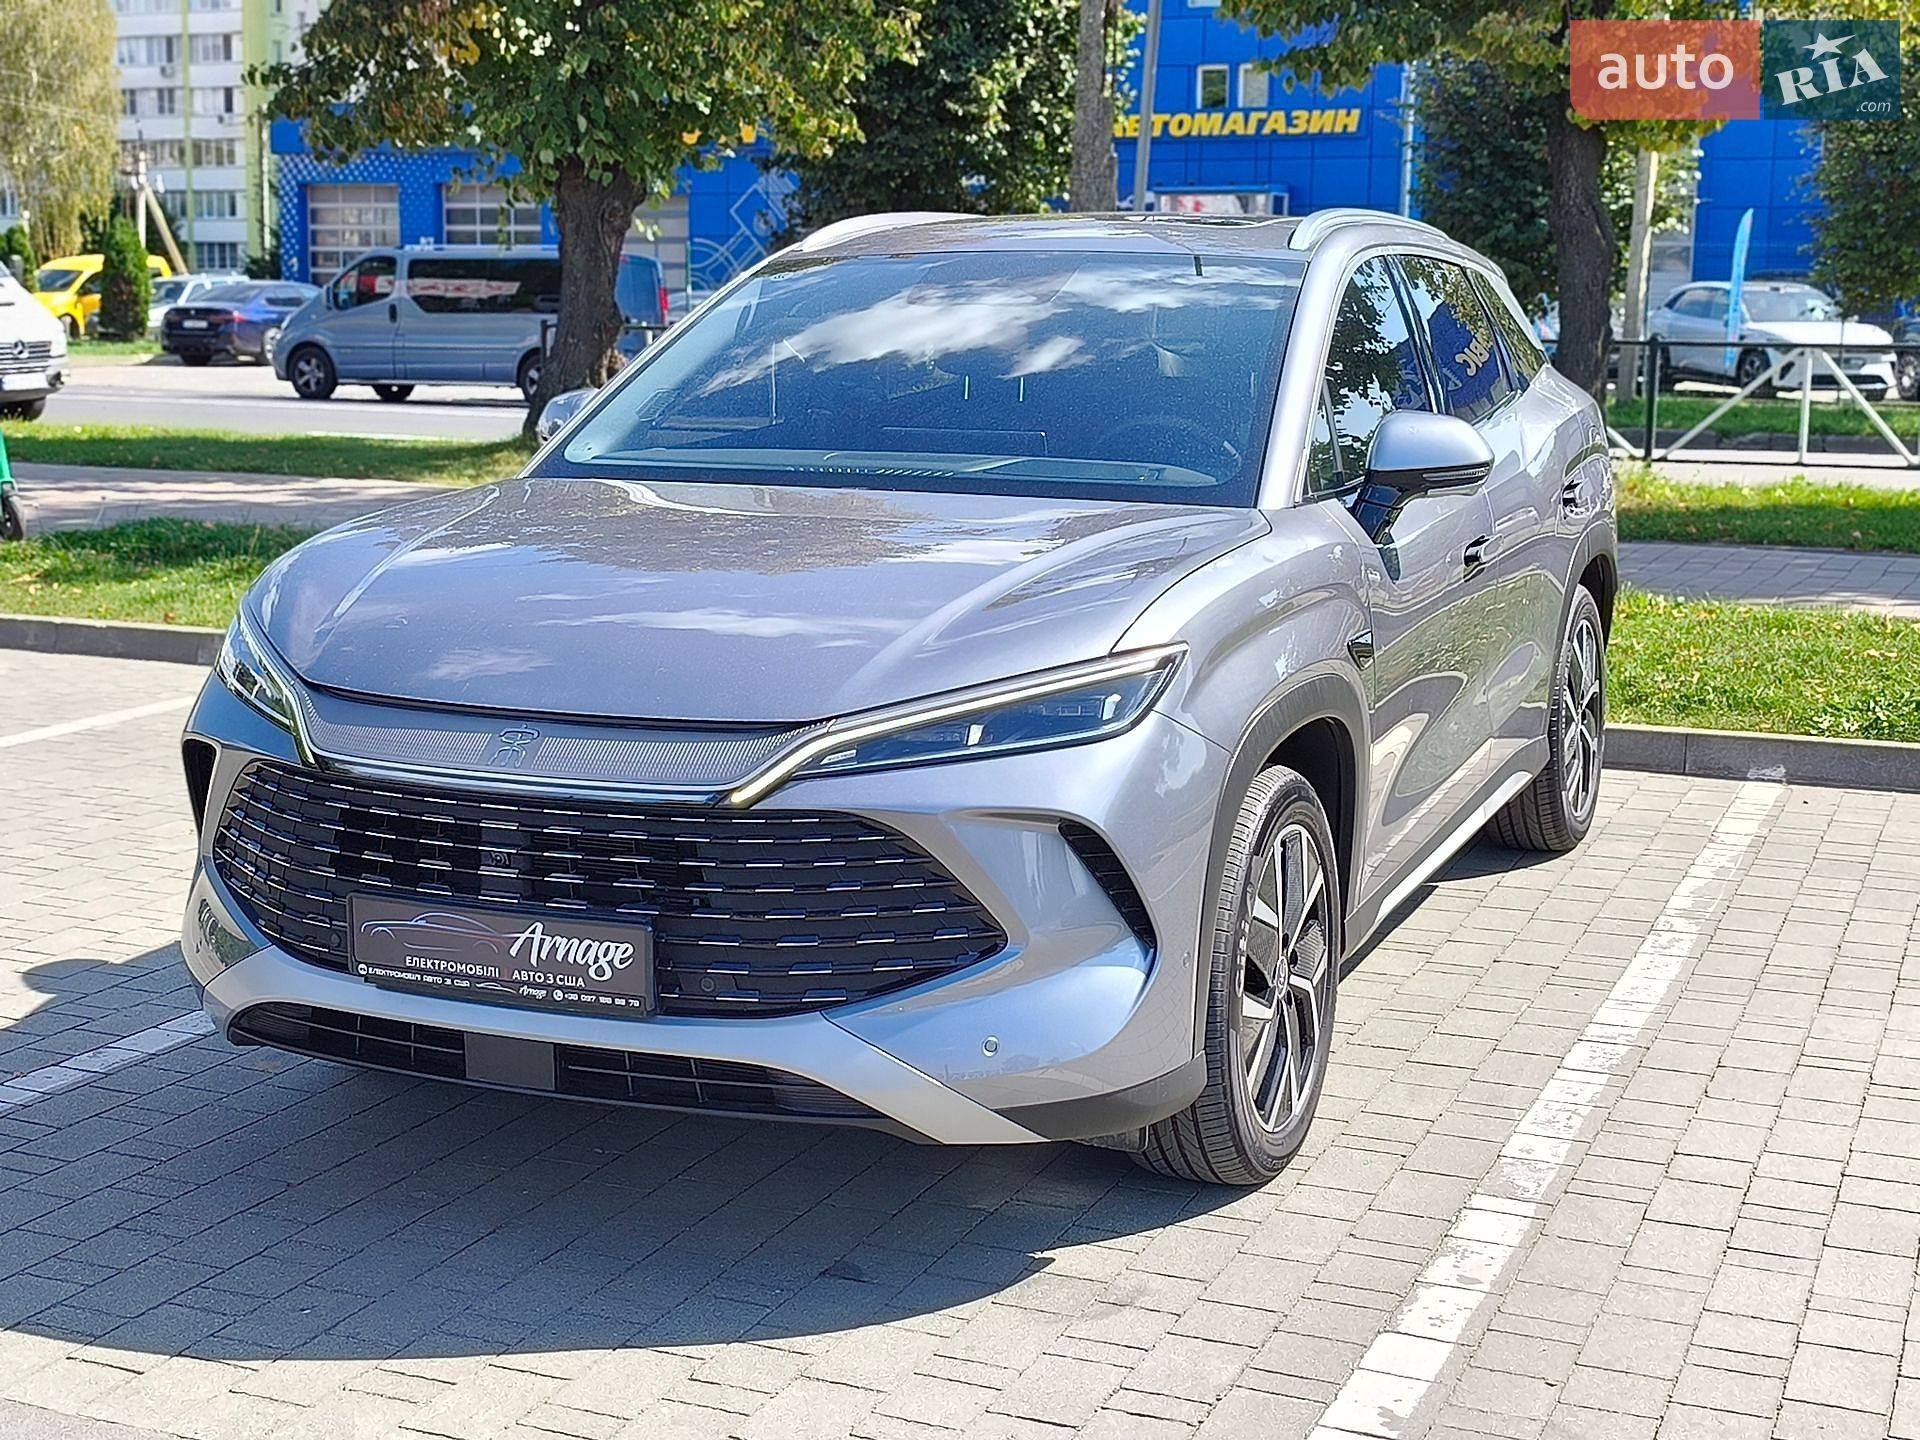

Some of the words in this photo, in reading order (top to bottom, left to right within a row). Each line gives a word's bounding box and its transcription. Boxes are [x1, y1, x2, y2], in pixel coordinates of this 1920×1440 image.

[509, 921, 635, 982] Arnage
[405, 956, 500, 978] ЕЛЕКТРОМОБІЛІ
[512, 969, 546, 984] АВТО
[555, 974, 586, 988] США
